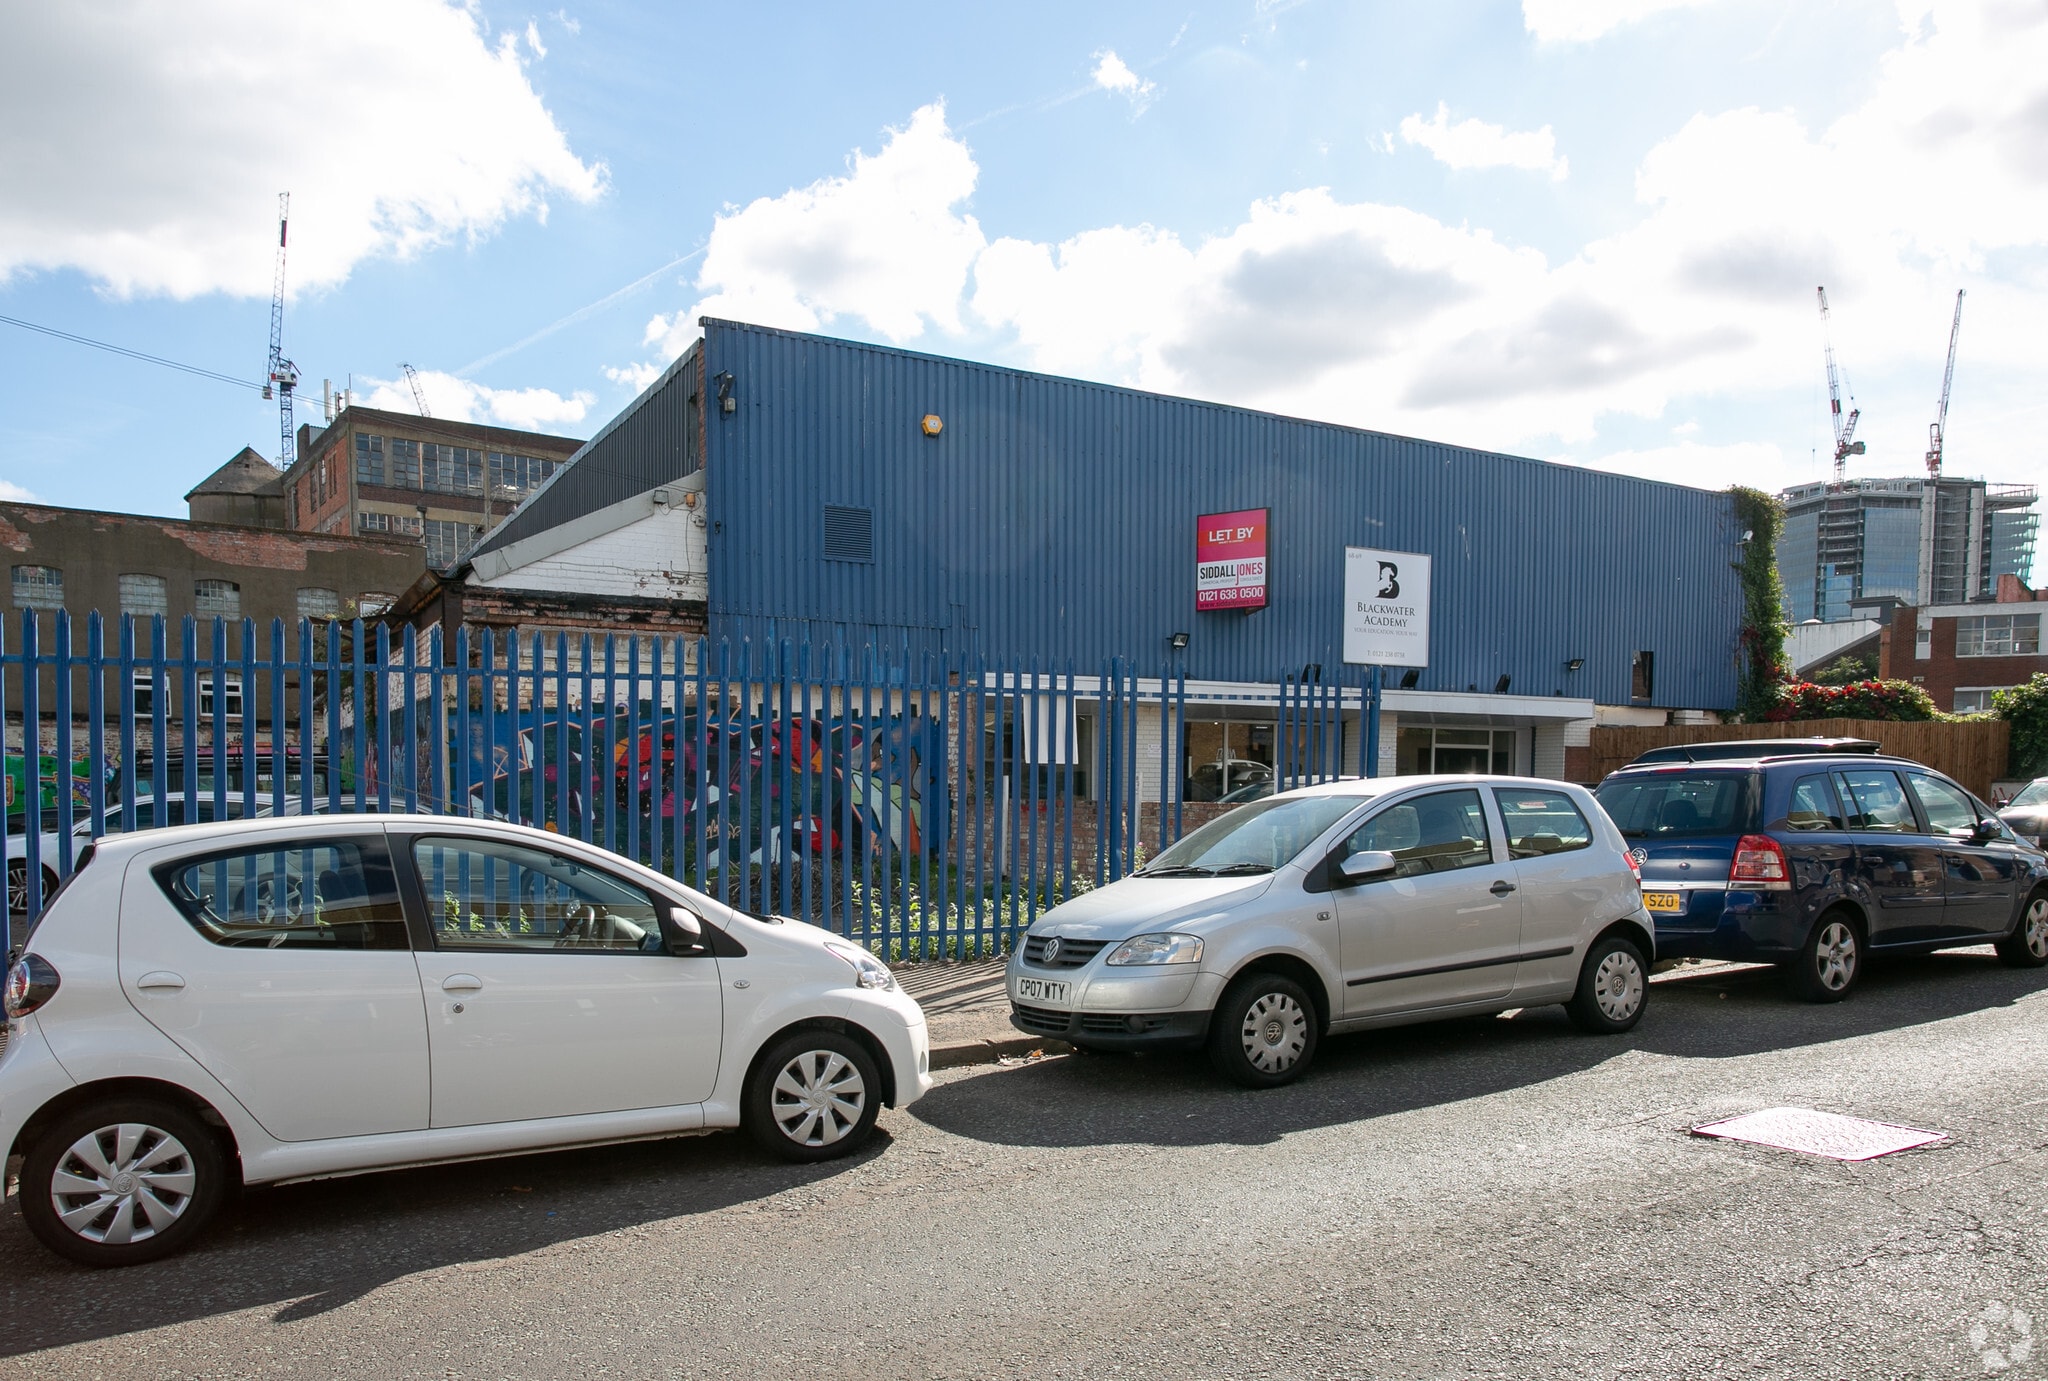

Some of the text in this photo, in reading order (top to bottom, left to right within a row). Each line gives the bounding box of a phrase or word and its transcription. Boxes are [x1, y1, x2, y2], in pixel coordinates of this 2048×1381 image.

[1208, 529, 1233, 542] LET
[1237, 526, 1254, 539] BY
[1200, 562, 1263, 586] SIDDALL JONES
[1199, 586, 1263, 602] 0121 638 0500
[1357, 602, 1416, 616] BLACKWATER
[1364, 615, 1408, 628] ACADEMY
[1649, 894, 1674, 907] SZO
[1020, 979, 1065, 1000] CP07 WTY
